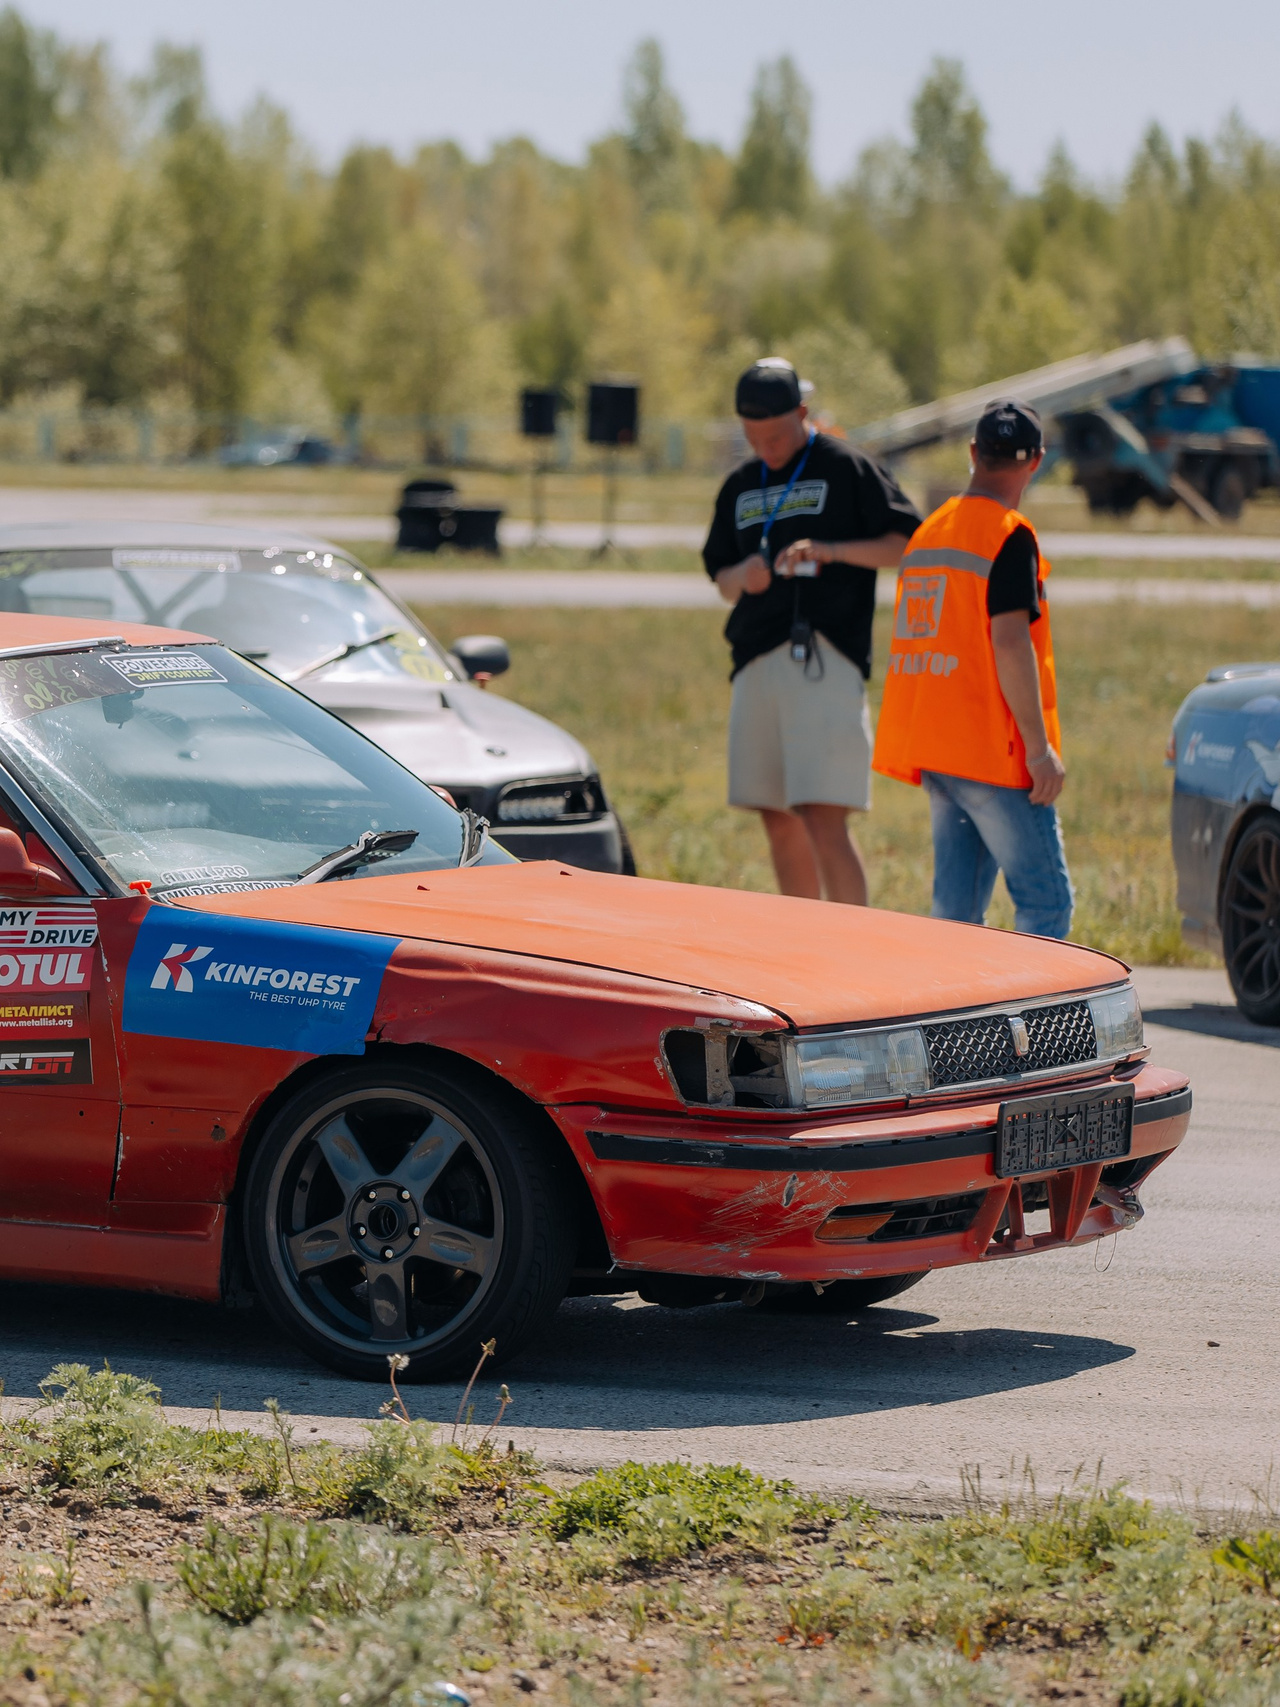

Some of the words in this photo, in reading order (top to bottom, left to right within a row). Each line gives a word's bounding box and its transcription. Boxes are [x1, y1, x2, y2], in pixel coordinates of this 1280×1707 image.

[111, 655, 211, 675] POWERSLIDE
[127, 670, 214, 682] DRIFTCONTEST
[29, 929, 96, 944] DRIVE
[204, 961, 361, 998] KINFOREST
[249, 990, 268, 1002] THE
[270, 993, 296, 1005] BEST
[298, 996, 320, 1008] UHP
[322, 999, 347, 1011] TYRE
